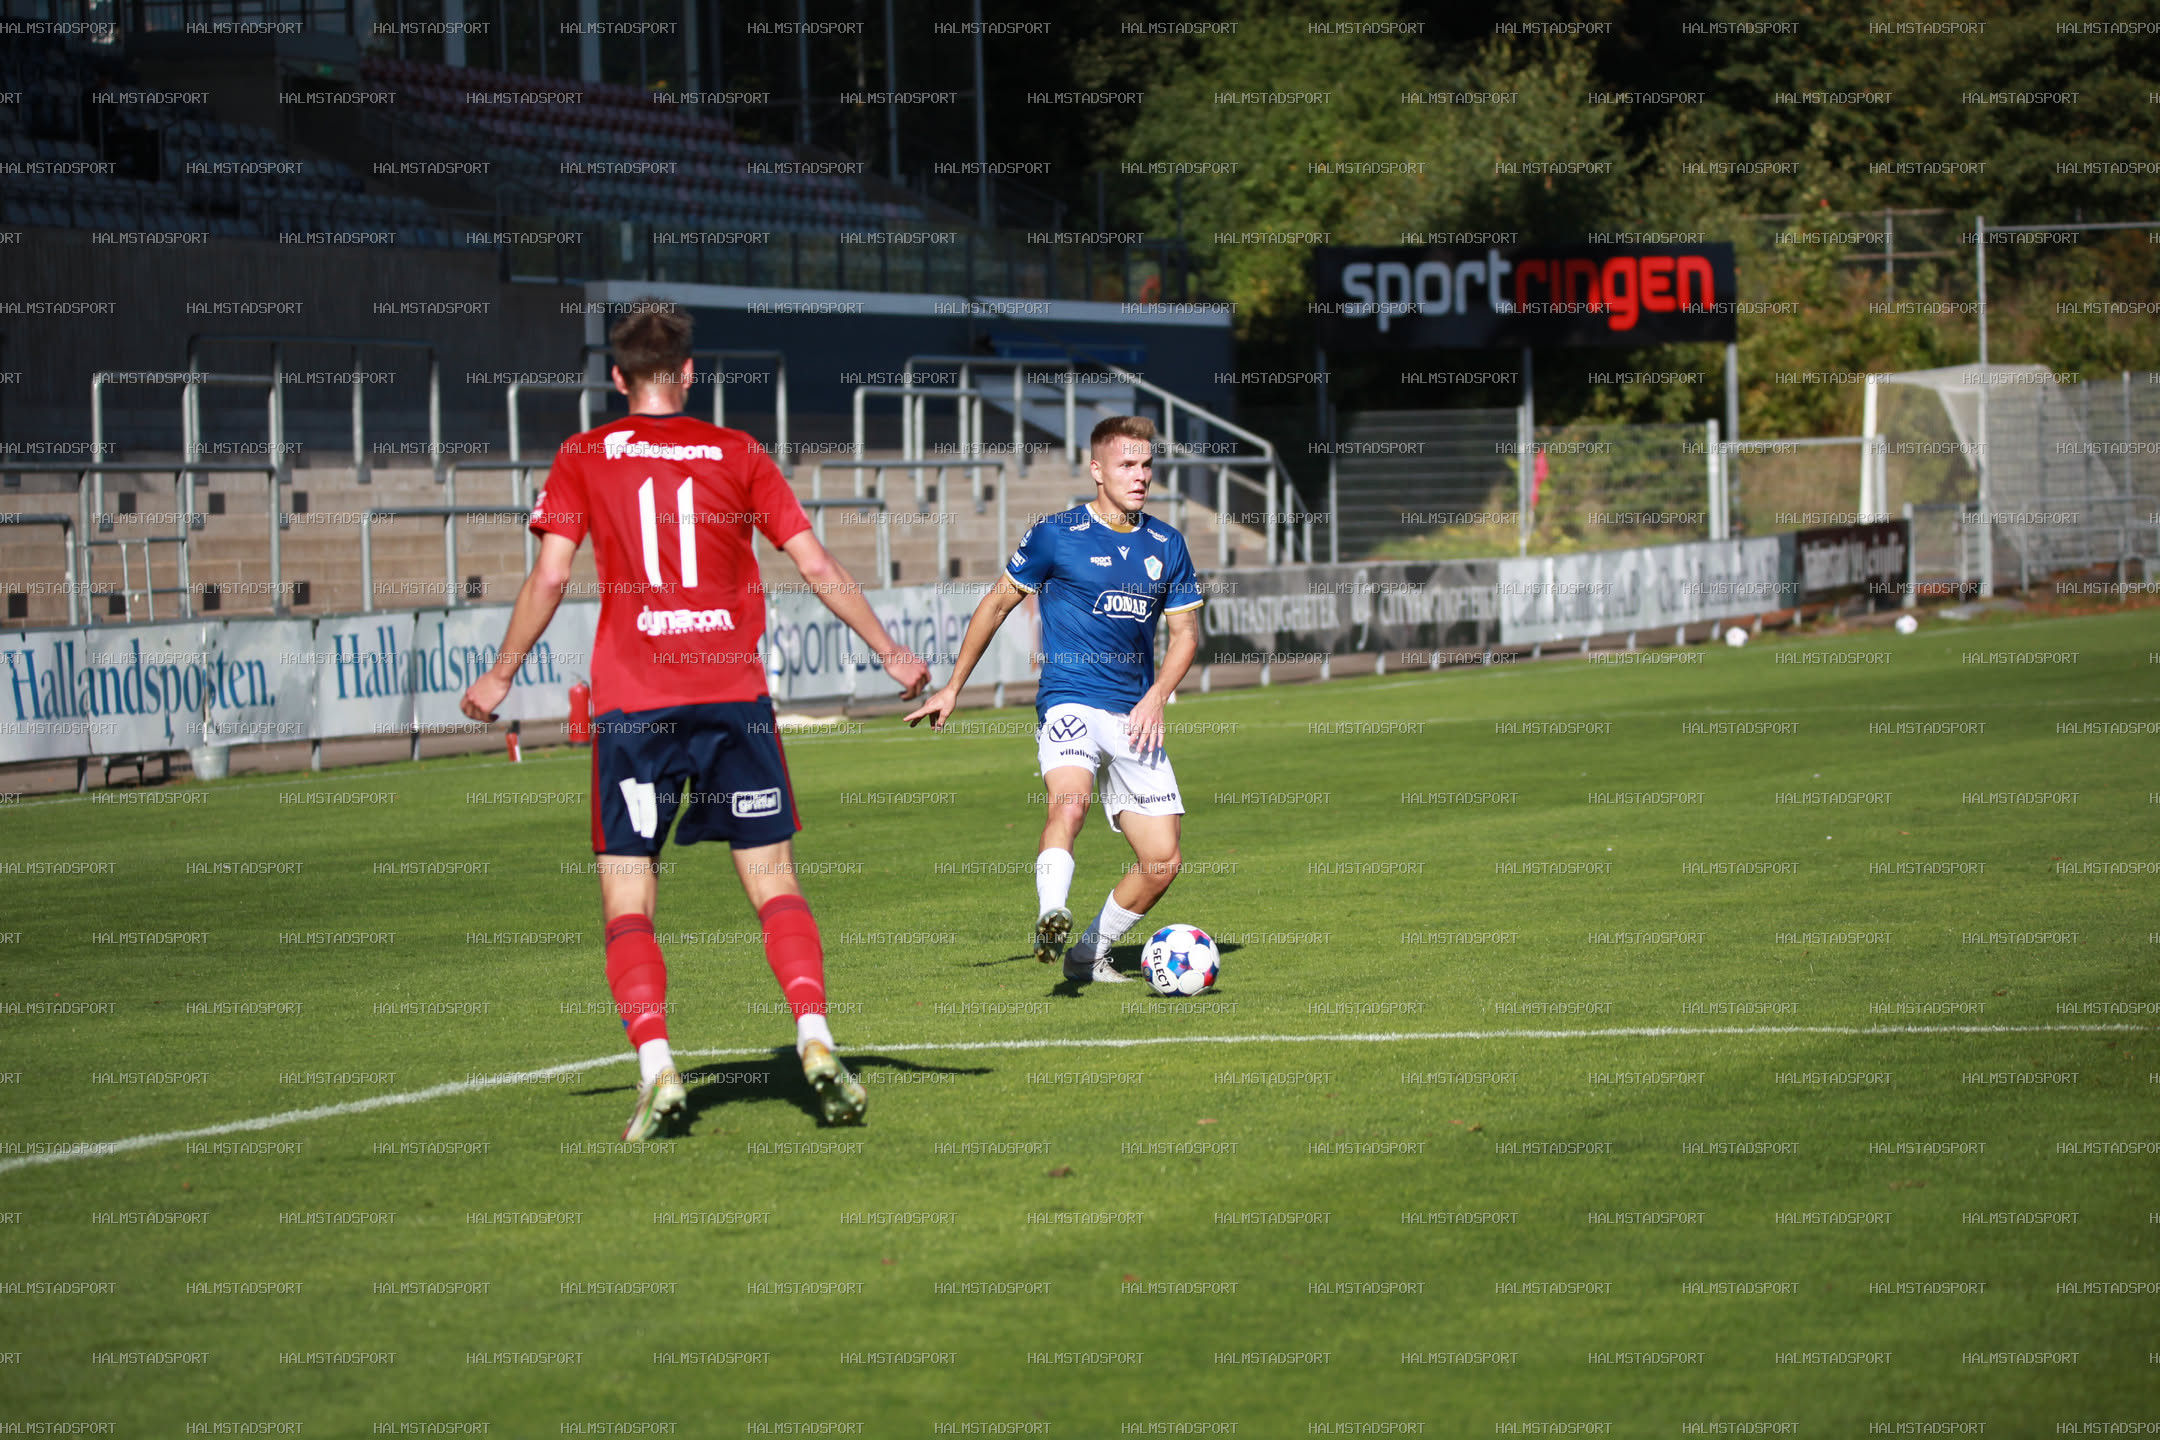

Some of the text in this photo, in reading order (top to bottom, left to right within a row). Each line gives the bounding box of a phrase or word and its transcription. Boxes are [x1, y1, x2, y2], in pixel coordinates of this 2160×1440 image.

[1342, 249, 1717, 333] sportringen
[638, 476, 698, 588] 11
[637, 604, 733, 636] dynacon
[1103, 595, 1149, 617] JONAB
[1153, 947, 1171, 988] SELECT
